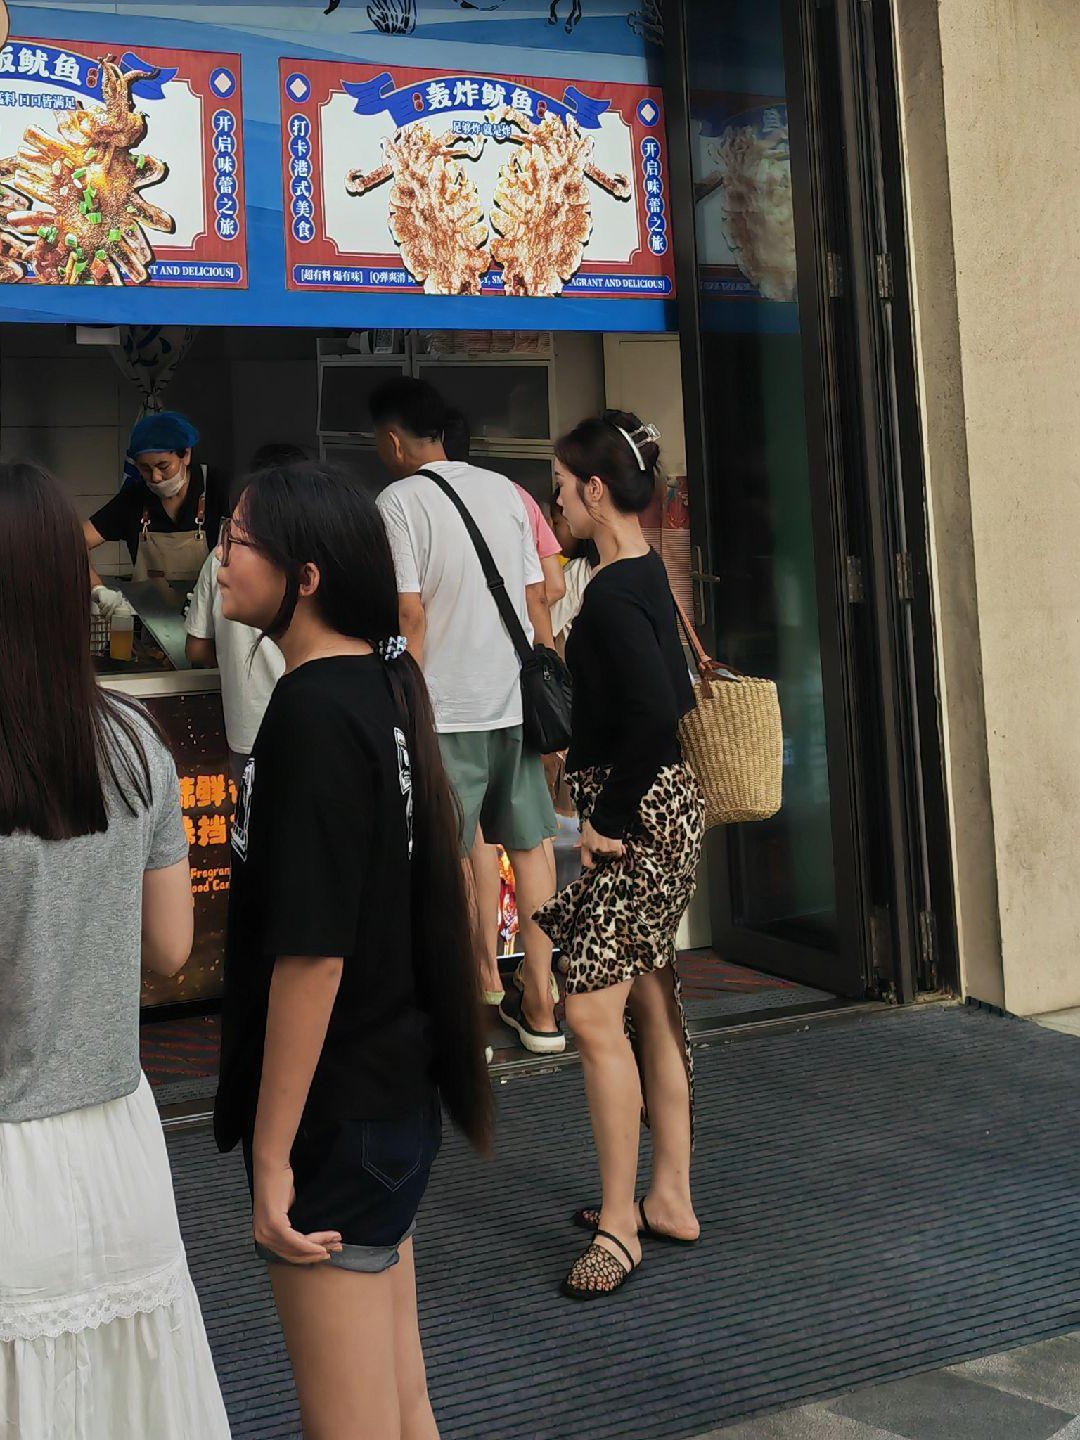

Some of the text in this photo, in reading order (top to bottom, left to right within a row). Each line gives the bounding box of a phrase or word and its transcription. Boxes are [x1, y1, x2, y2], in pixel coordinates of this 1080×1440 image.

[425, 79, 534, 117] 轰炸鱿鱼
[217, 115, 236, 235] 开启味蕾之旅
[290, 119, 312, 240] 打卡港式美食
[644, 140, 665, 252] 开启味蕾之旅
[161, 266, 180, 276] AND
[605, 278, 622, 288] AND
